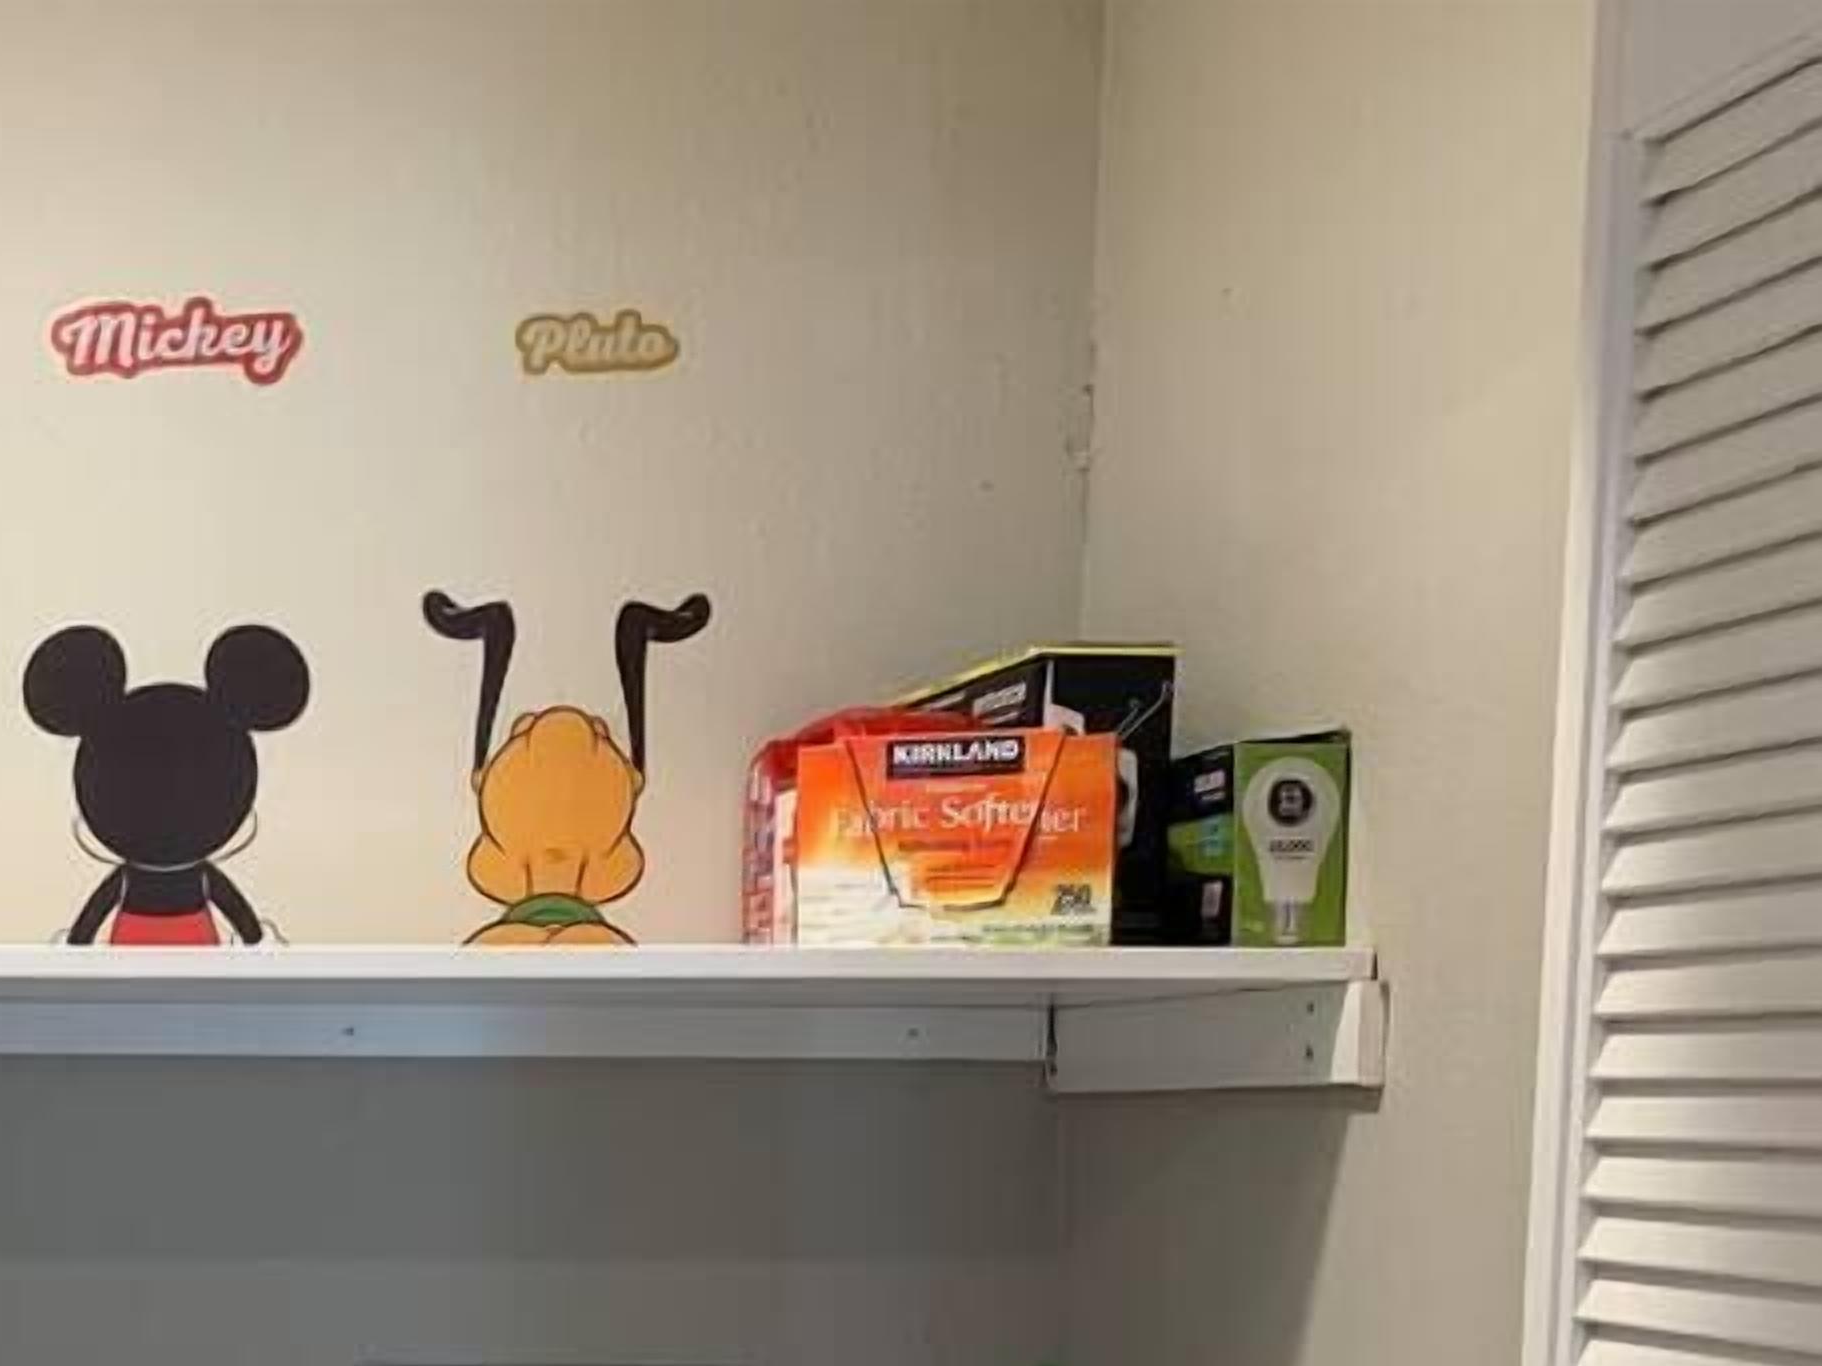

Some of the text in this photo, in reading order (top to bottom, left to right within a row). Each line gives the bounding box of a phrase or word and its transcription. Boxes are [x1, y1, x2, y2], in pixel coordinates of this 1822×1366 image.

[59, 303, 291, 375] Mickey
[522, 315, 674, 368] Pluto
[892, 739, 1019, 766] KIRKLAND
